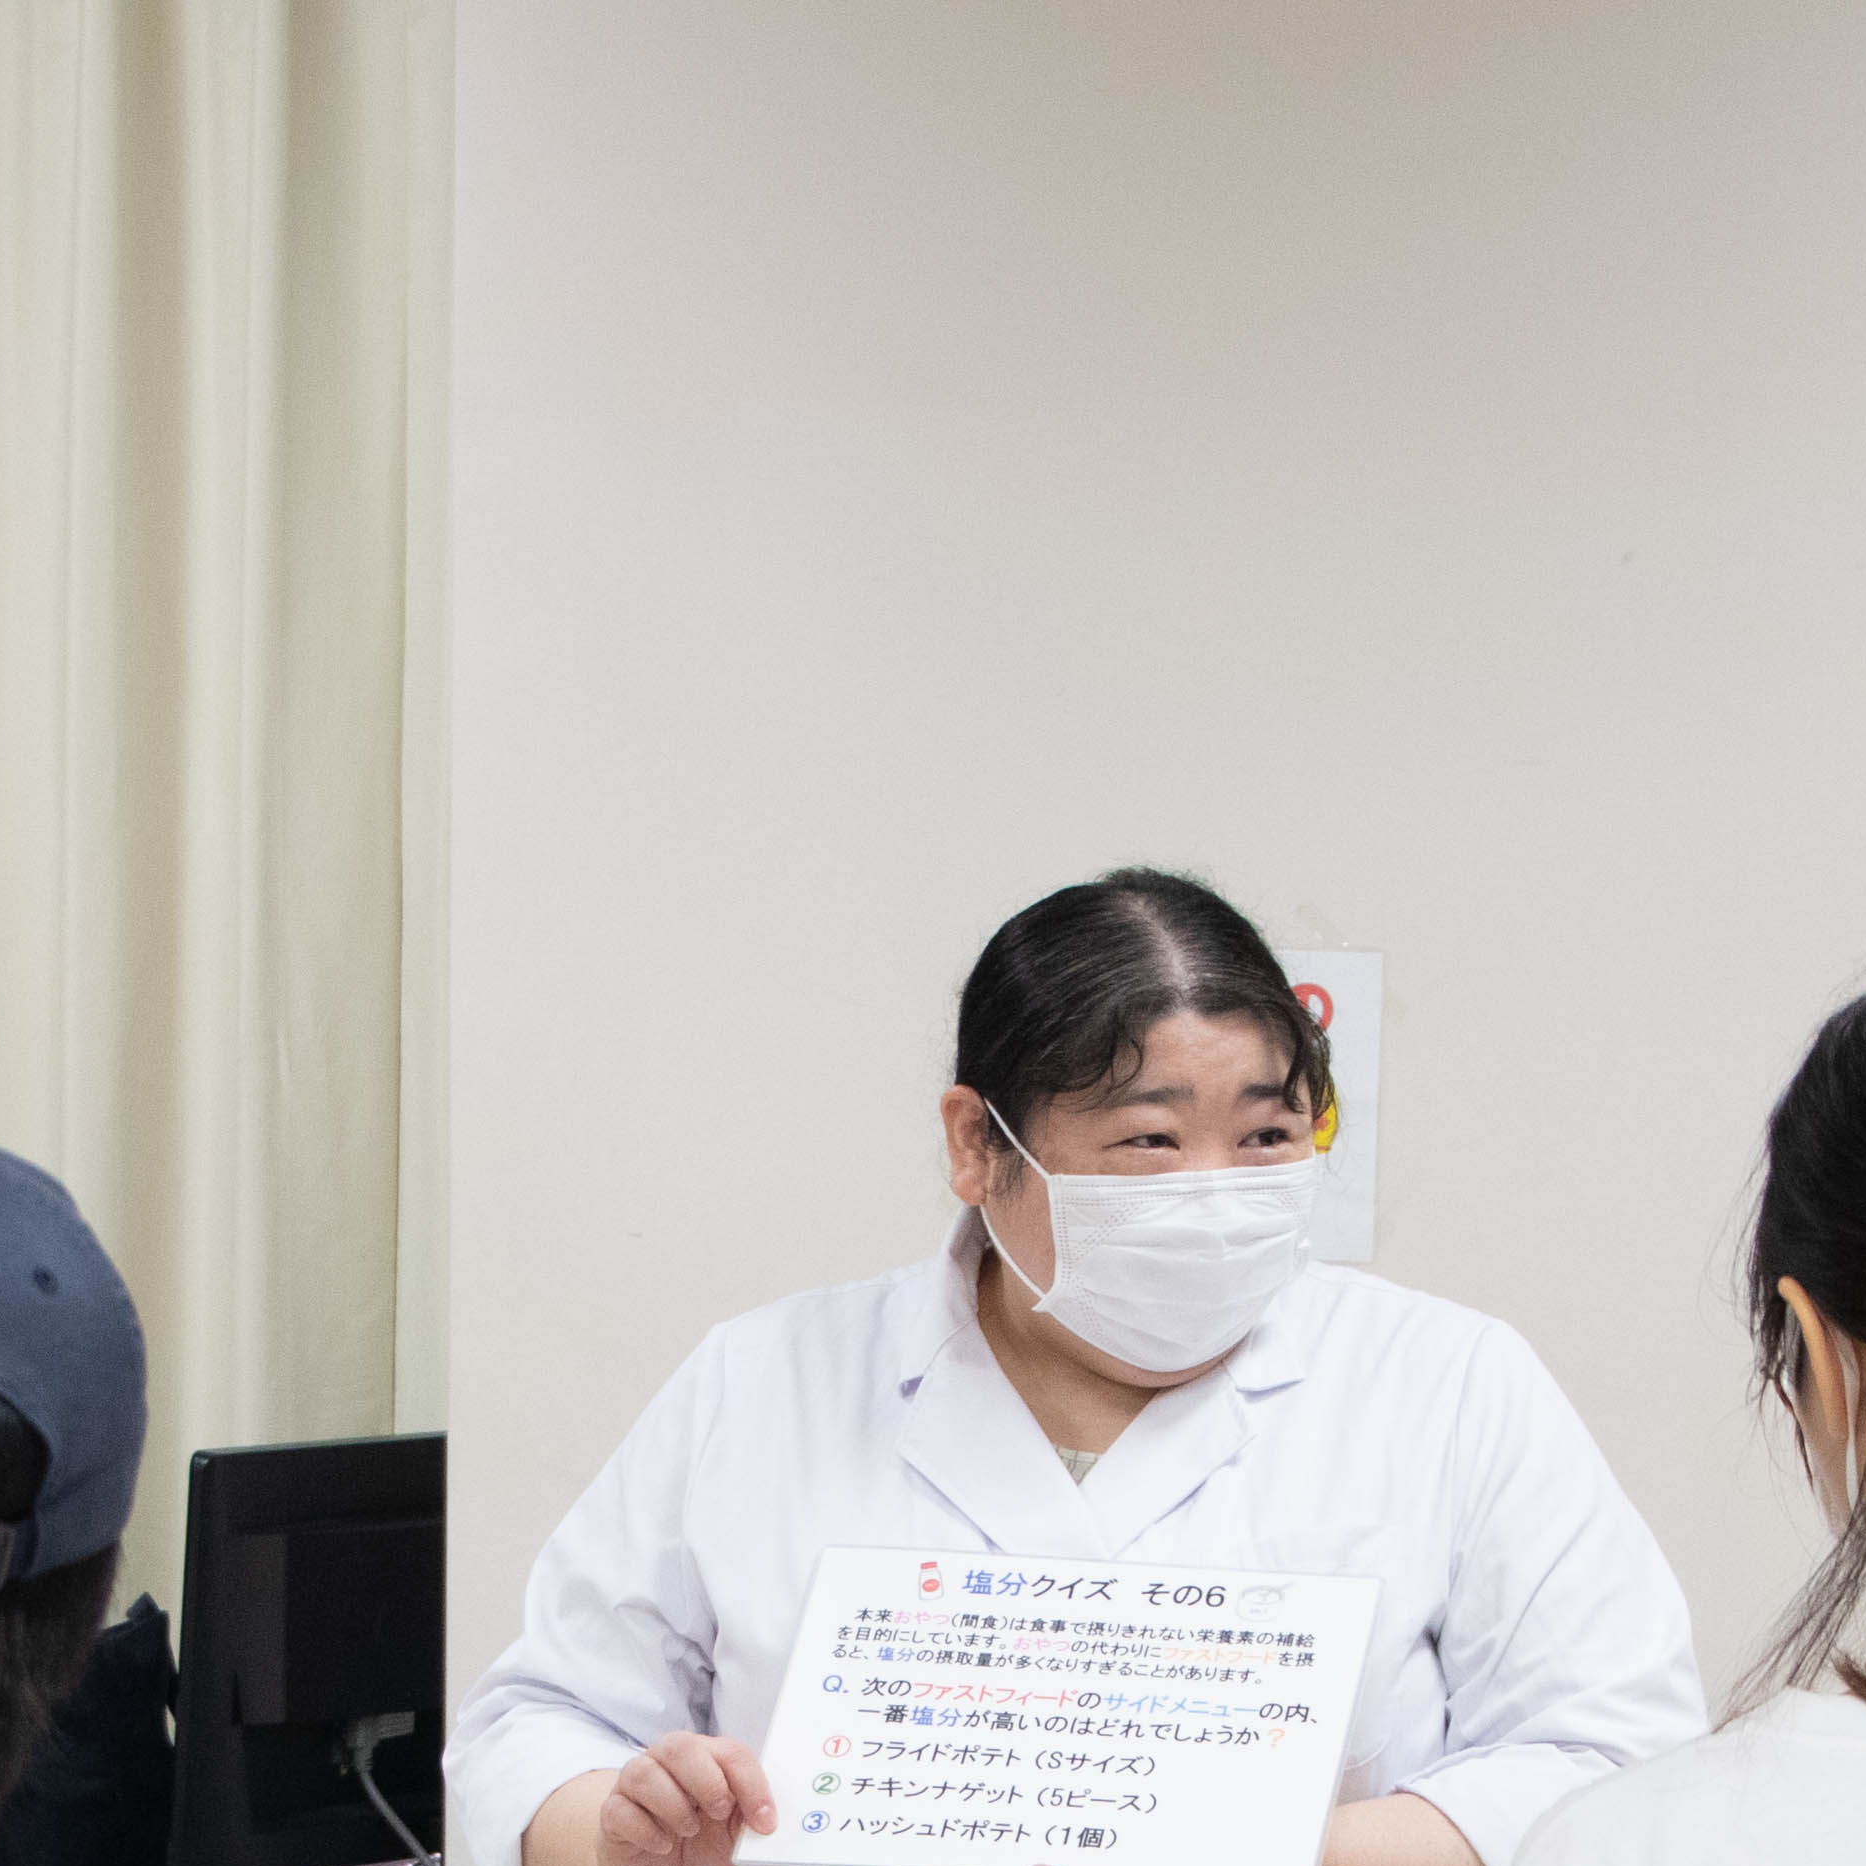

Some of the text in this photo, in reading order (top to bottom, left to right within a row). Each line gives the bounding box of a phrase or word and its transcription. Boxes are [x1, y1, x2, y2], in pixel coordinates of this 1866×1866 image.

[961, 1569, 1227, 1608] 塩分クイズ その6
